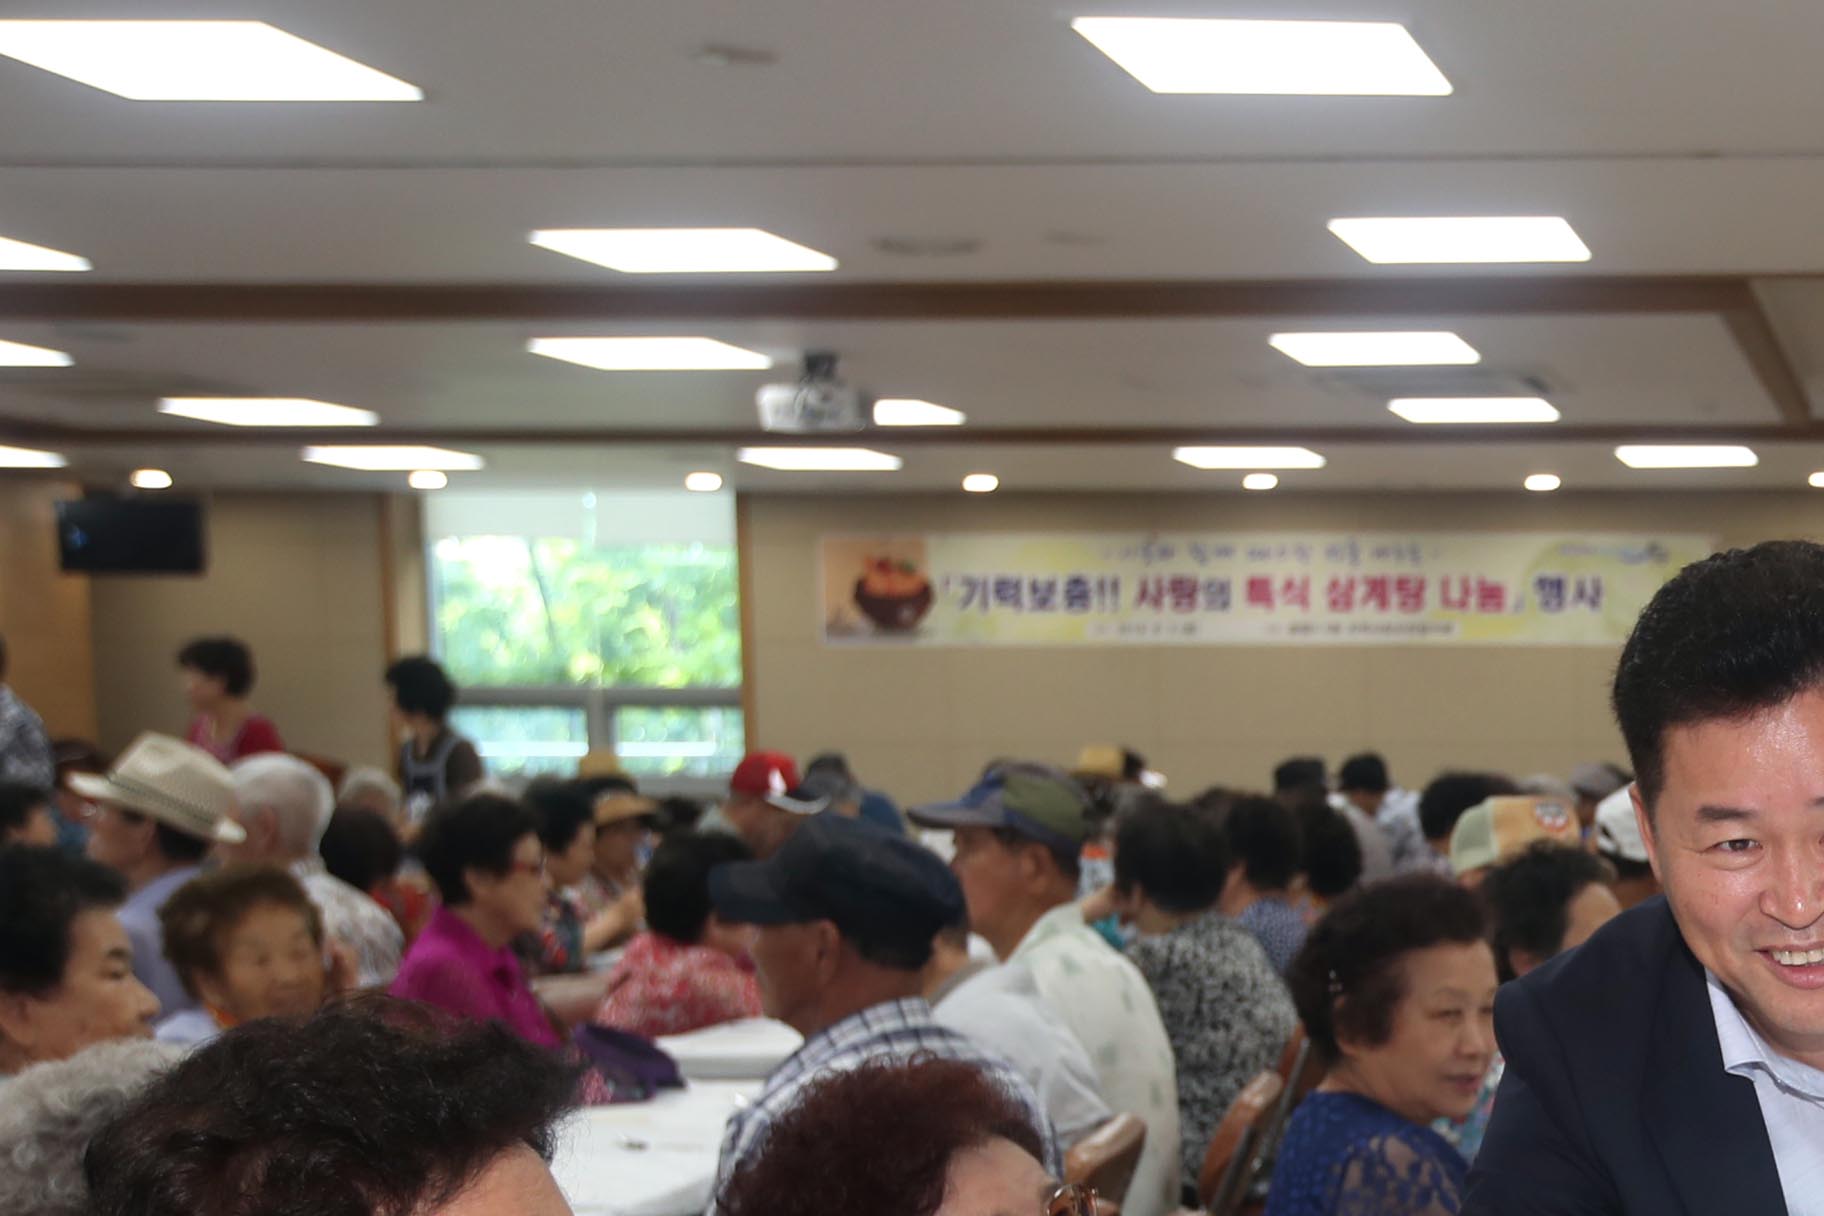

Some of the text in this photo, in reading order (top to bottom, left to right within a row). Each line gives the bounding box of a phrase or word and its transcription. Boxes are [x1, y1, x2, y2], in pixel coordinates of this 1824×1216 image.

[1246, 575, 1311, 613] 특식
[1326, 574, 1426, 614] 삼계탕
[1534, 575, 1603, 614] 행사
